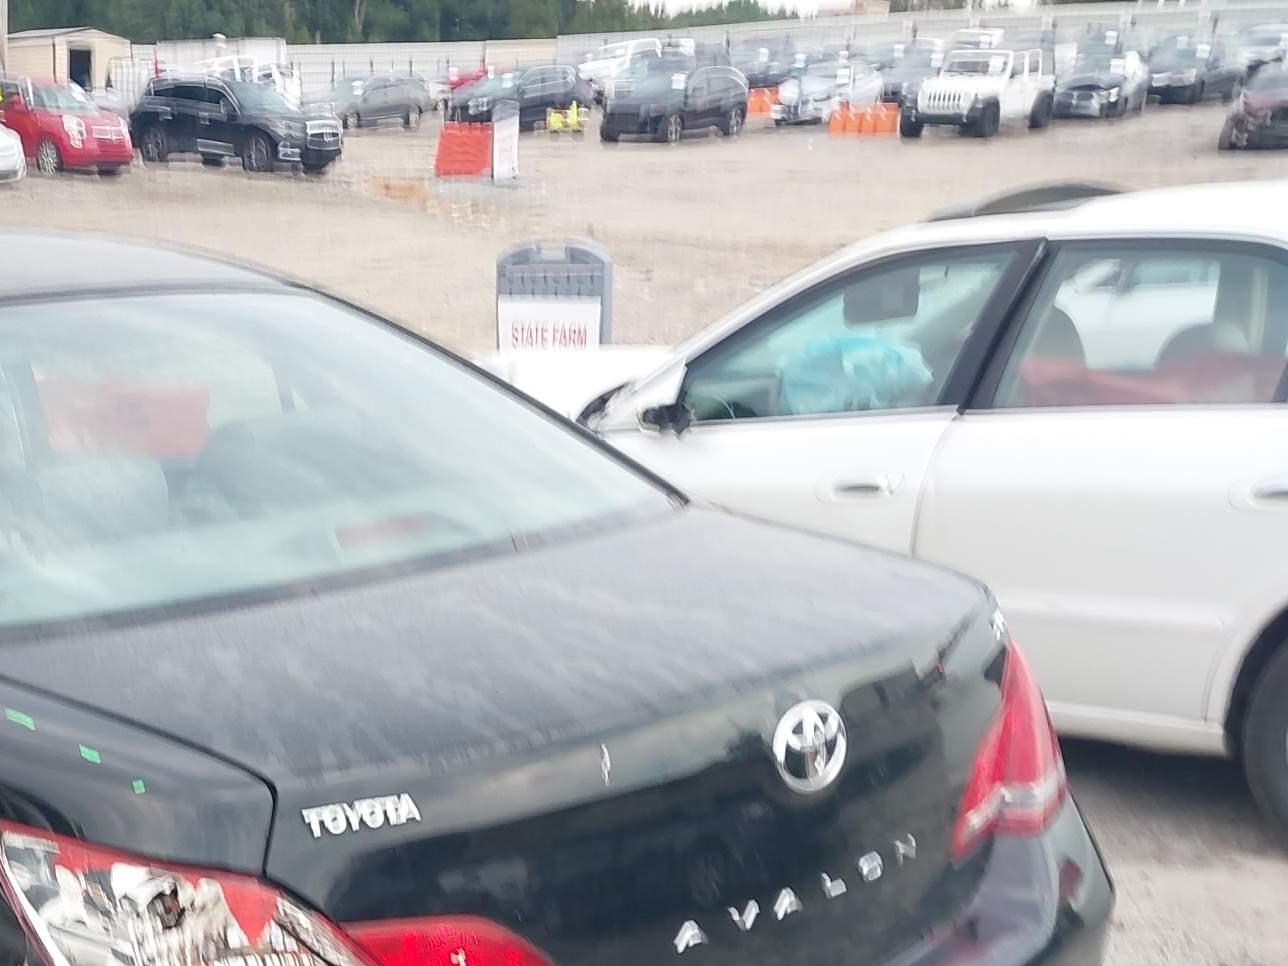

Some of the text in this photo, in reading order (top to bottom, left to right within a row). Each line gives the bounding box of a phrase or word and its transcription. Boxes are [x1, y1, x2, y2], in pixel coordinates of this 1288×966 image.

[511, 320, 588, 349] STATE FARM
[301, 793, 423, 838] TOYOTA
[673, 833, 917, 954] AVALON
